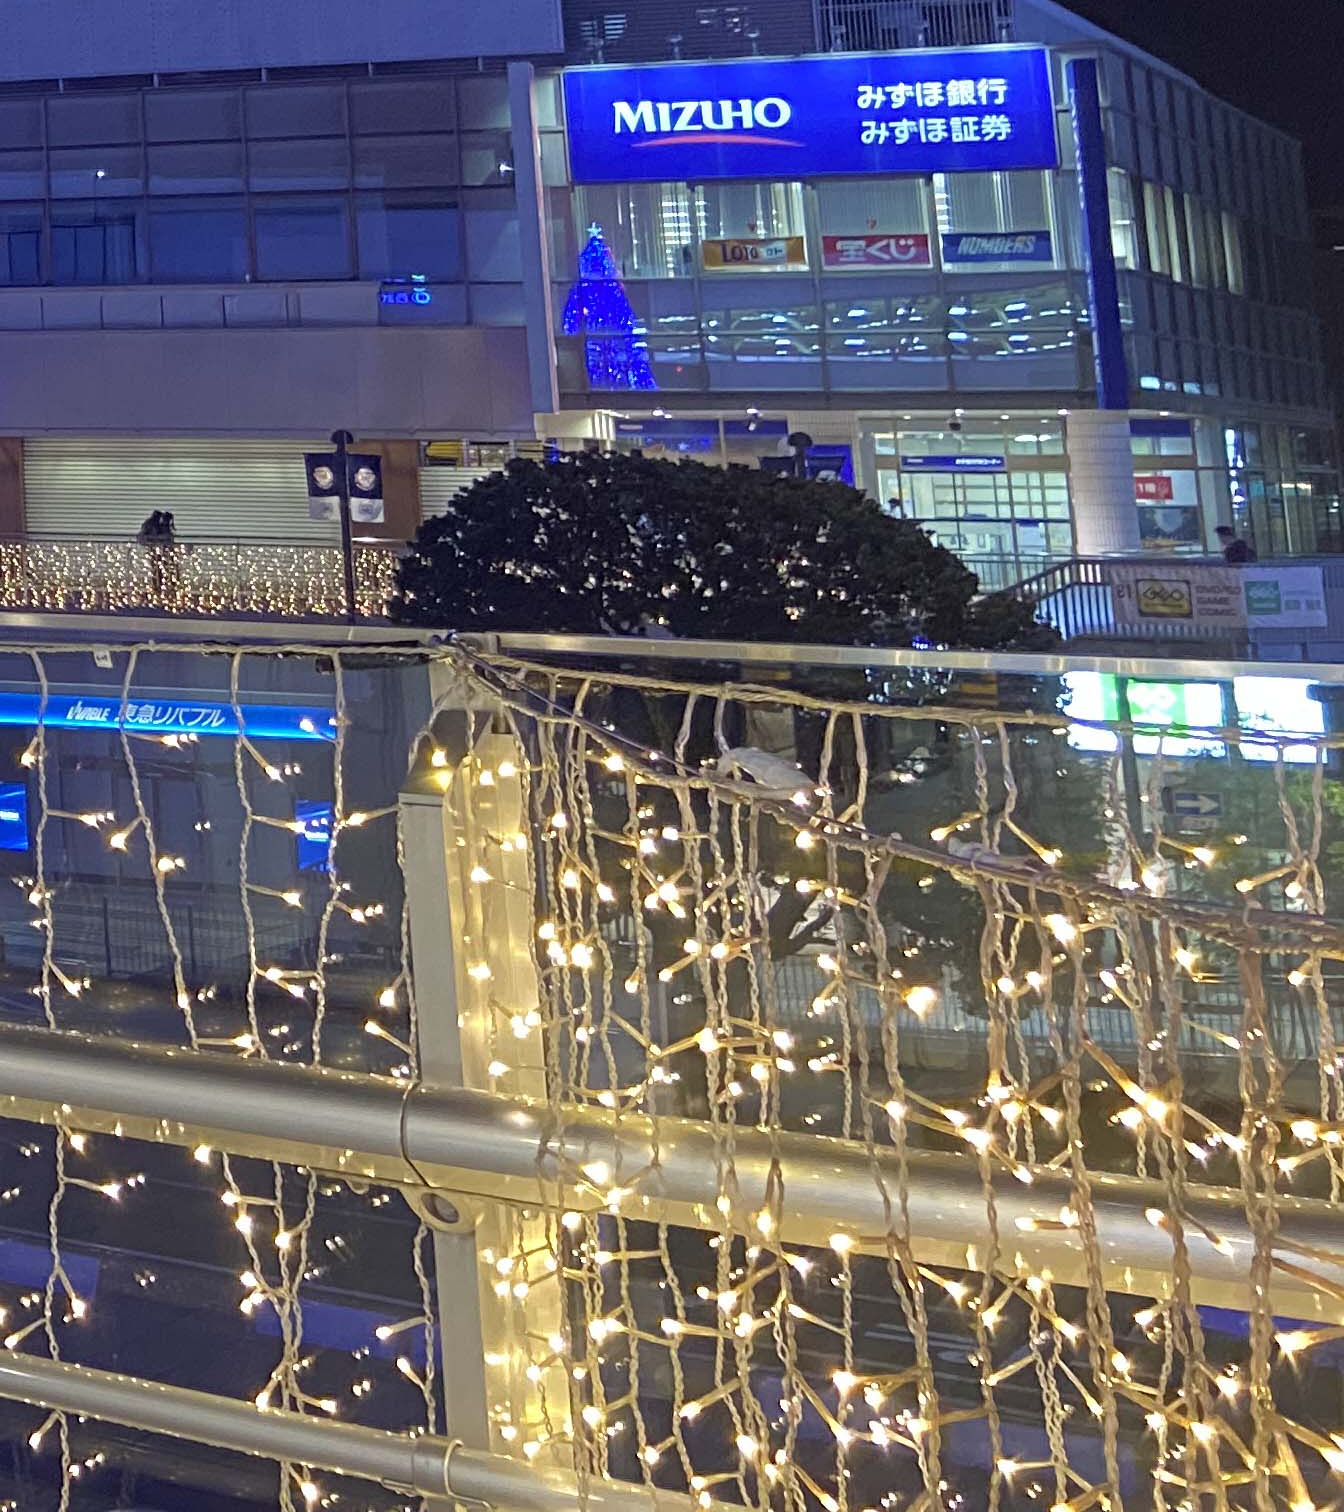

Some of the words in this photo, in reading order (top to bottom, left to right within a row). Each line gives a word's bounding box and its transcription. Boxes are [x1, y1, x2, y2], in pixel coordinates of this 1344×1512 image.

[857, 78, 1008, 109] みずほ銀行
[613, 97, 792, 134] MIZUHO
[861, 114, 1012, 145] みずほ証券
[835, 237, 917, 262] 宝くじ
